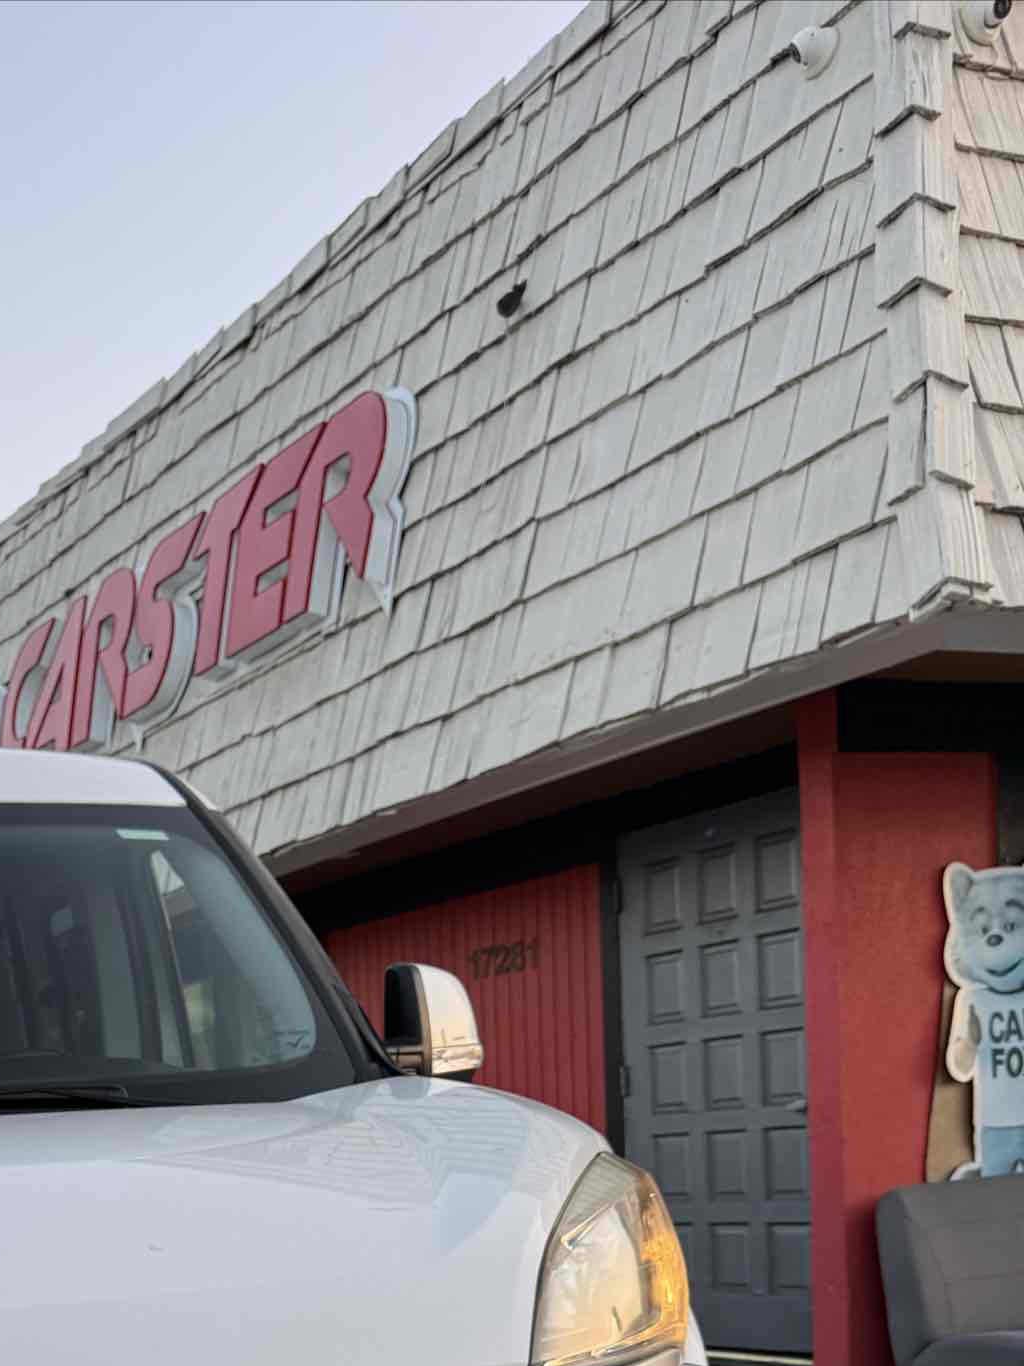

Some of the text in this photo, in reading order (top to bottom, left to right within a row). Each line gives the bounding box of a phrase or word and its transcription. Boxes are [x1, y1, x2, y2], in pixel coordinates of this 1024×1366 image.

[0, 388, 414, 752] CARSTER
[988, 1008, 1024, 1043] CA
[991, 1047, 1024, 1079] FO
